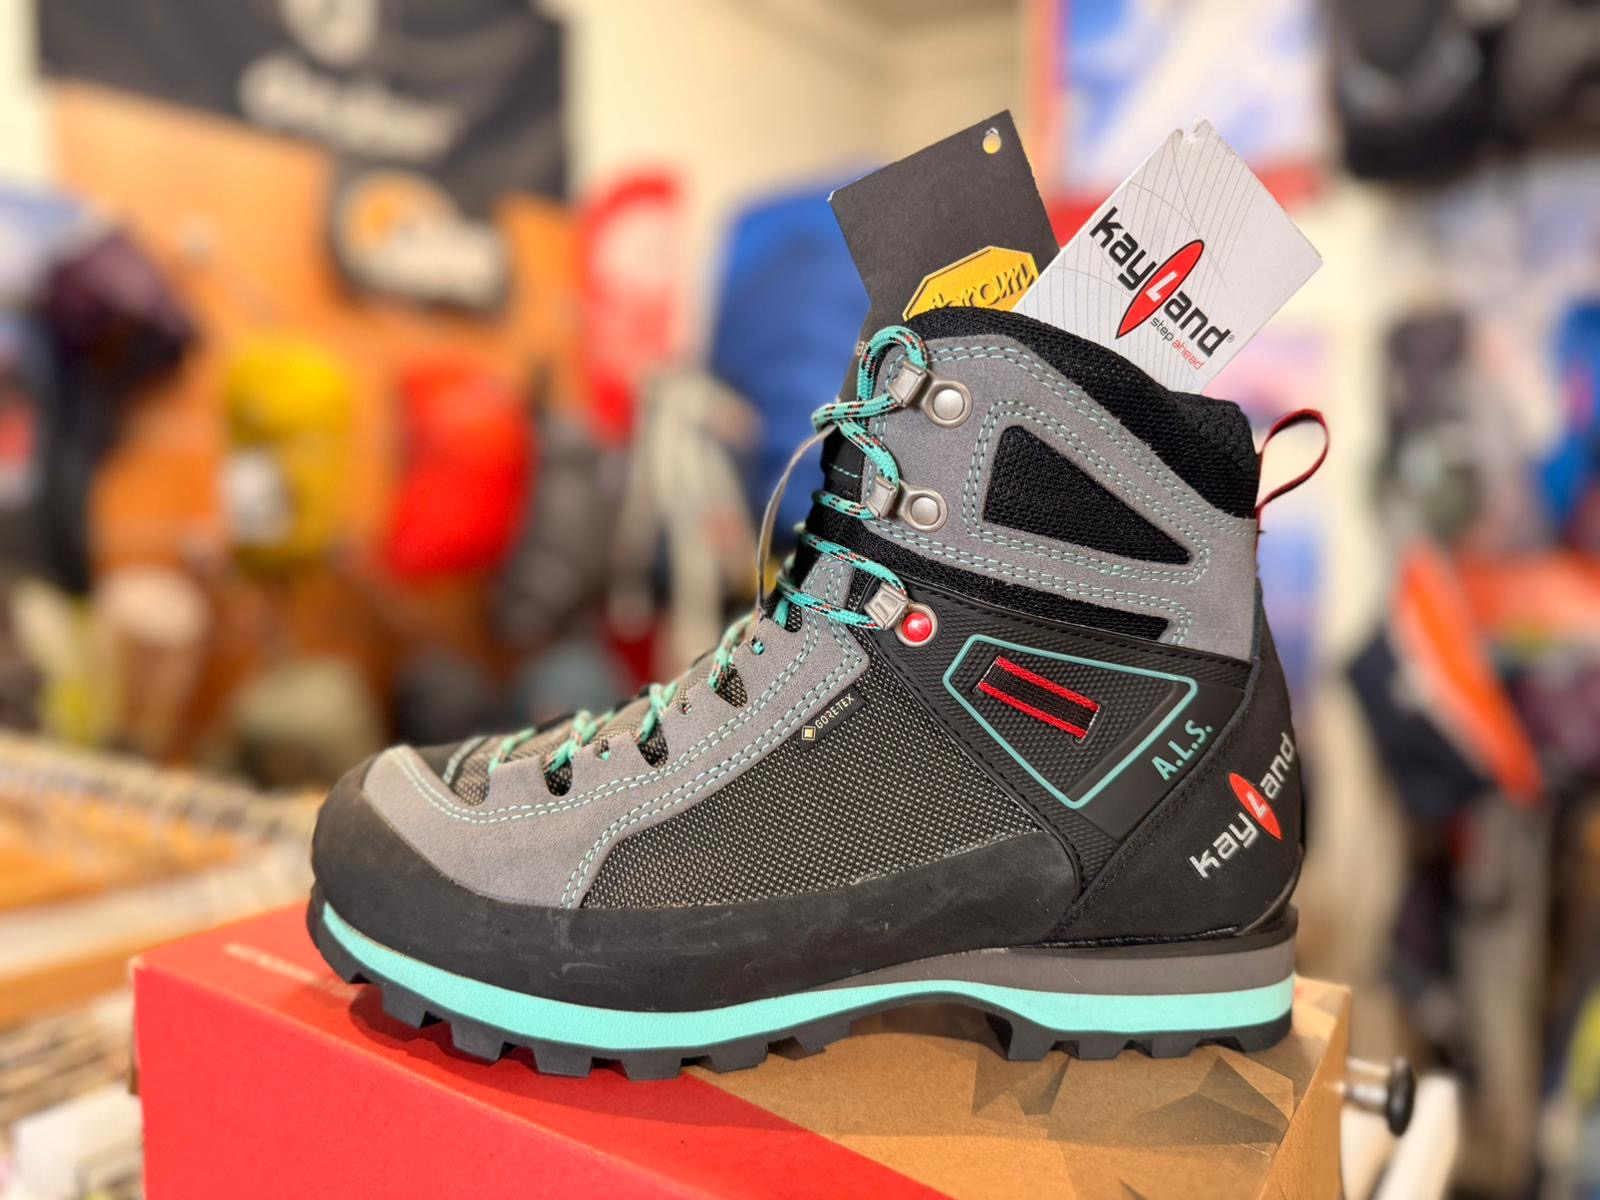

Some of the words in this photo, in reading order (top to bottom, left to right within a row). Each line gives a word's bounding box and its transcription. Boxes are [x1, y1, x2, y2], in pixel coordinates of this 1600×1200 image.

[1150, 317, 1174, 342] step
[1172, 338, 1205, 370] ahead
[1152, 719, 1213, 780] A.L.S.
